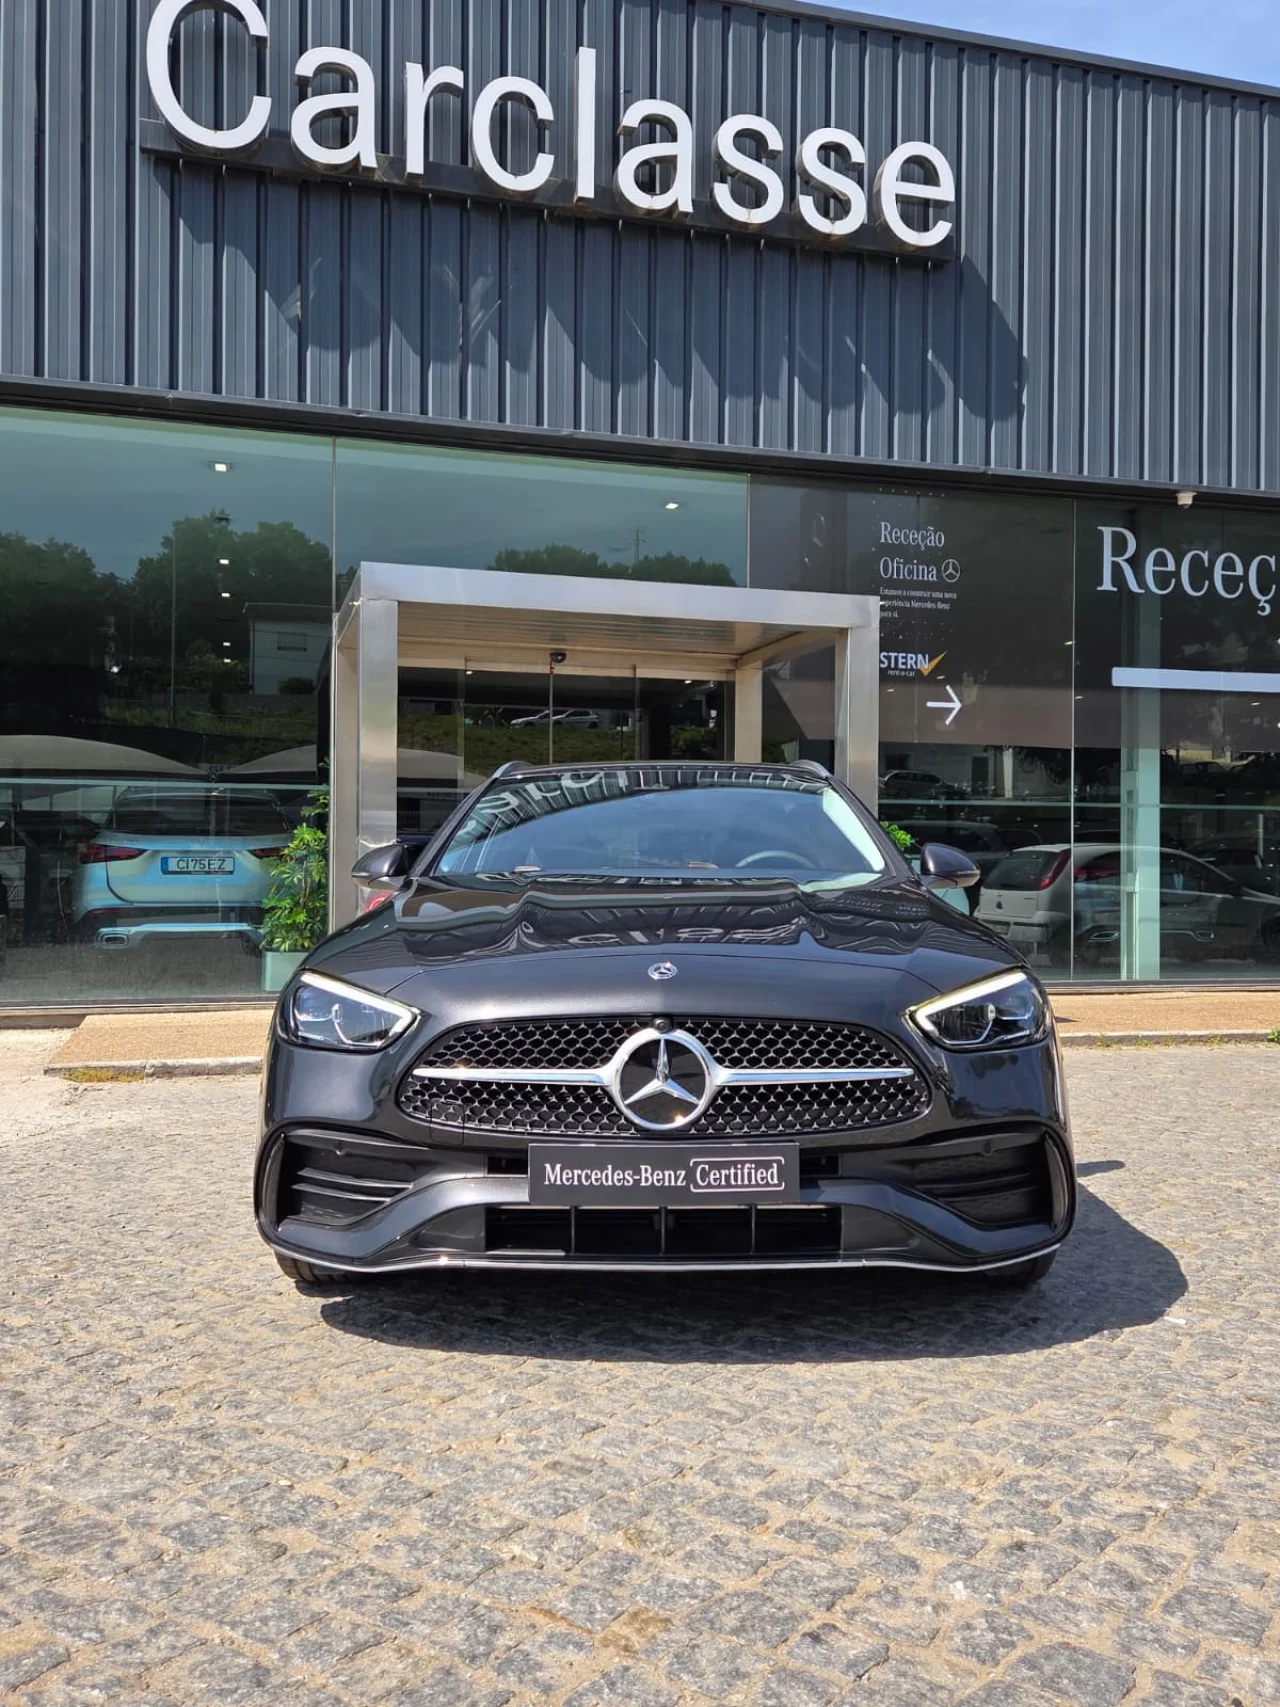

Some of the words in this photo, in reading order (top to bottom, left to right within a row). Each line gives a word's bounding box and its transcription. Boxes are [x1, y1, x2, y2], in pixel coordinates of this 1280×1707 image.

[146, 0, 956, 248] Carclasse
[880, 521, 945, 551] Receção
[880, 556, 938, 581] Oficina
[1096, 525, 1276, 617] Receç
[911, 599, 951, 610] Mercedes-Benz
[880, 652, 929, 669] STERN
[887, 669, 915, 677] rent-a-car
[544, 1163, 687, 1187] Mercedes-Benz
[695, 1163, 779, 1187] Certified
